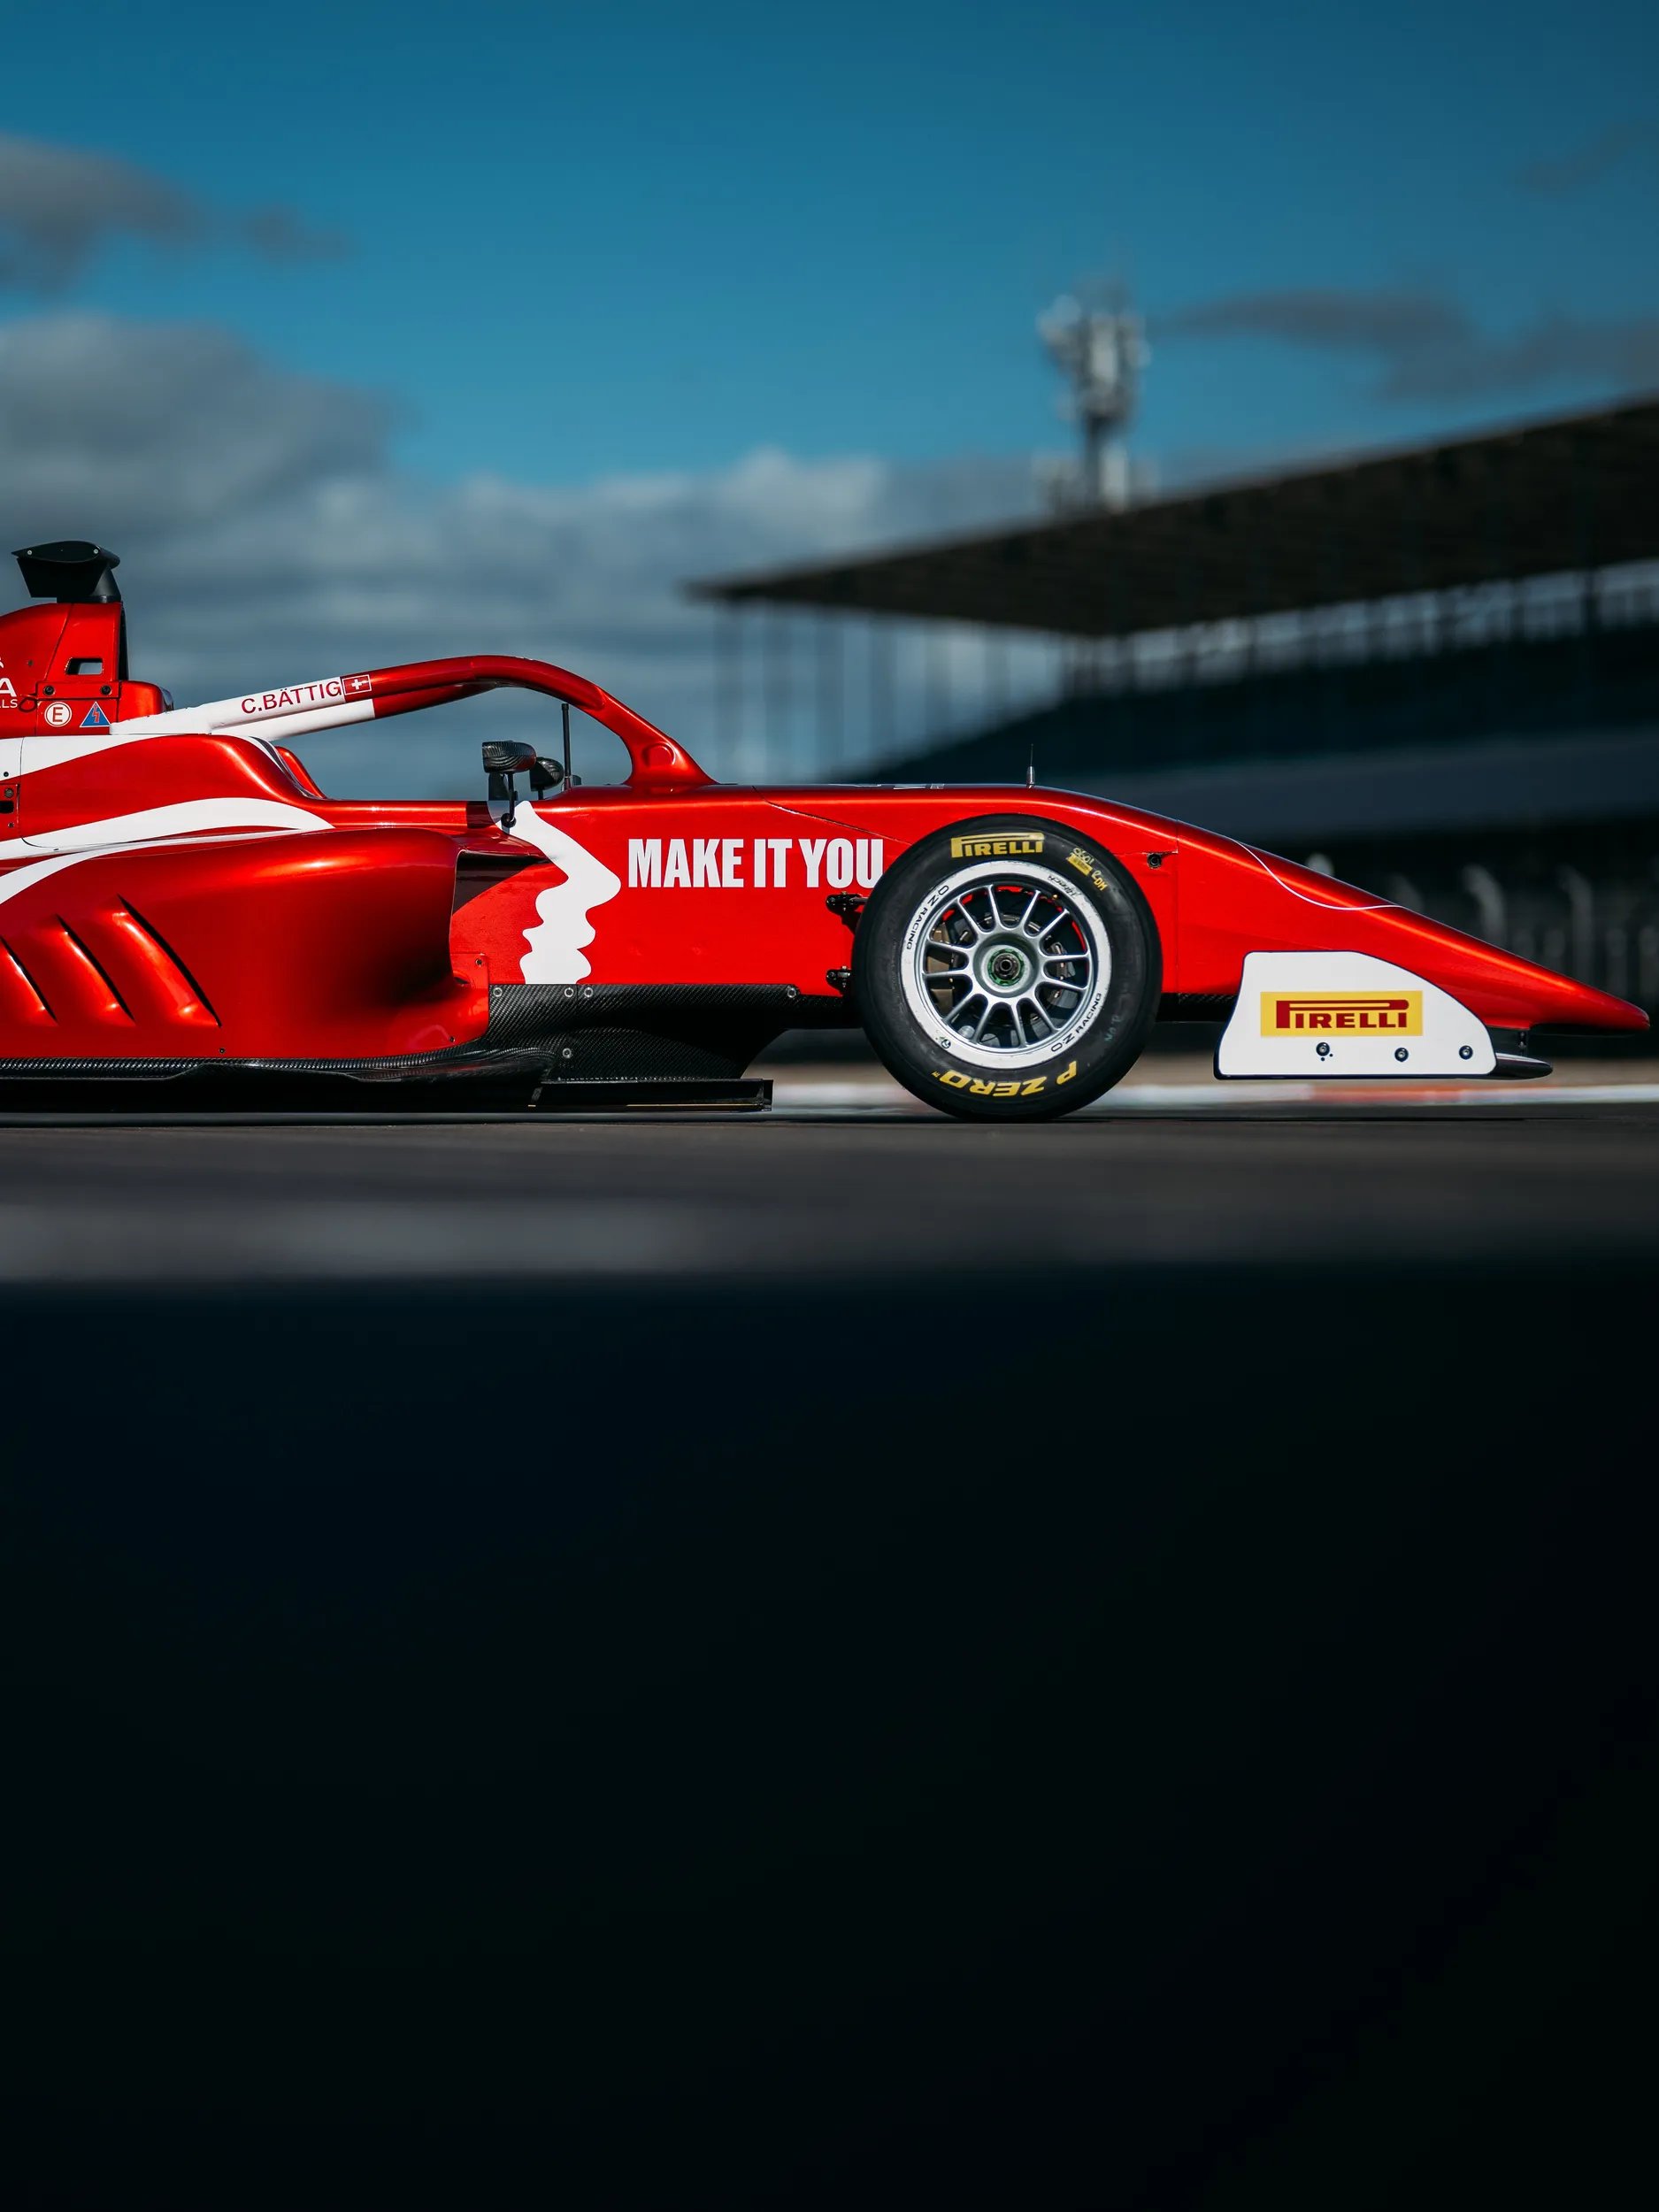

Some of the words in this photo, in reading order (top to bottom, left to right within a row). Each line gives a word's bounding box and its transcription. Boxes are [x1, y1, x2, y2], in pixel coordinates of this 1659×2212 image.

[241, 680, 342, 714] C.BÄTTIG
[53, 707, 64, 722] E
[950, 832, 1045, 858] PIRELLI
[628, 838, 744, 888] MAKE
[754, 838, 793, 888] IT
[798, 838, 884, 889] YOU
[906, 908, 928, 950] RACING
[1075, 992, 1102, 1033] RACING
[1275, 999, 1410, 1029] PIRELLI
[939, 1069, 1048, 1097] ZERO
[1056, 1060, 1077, 1085] P
